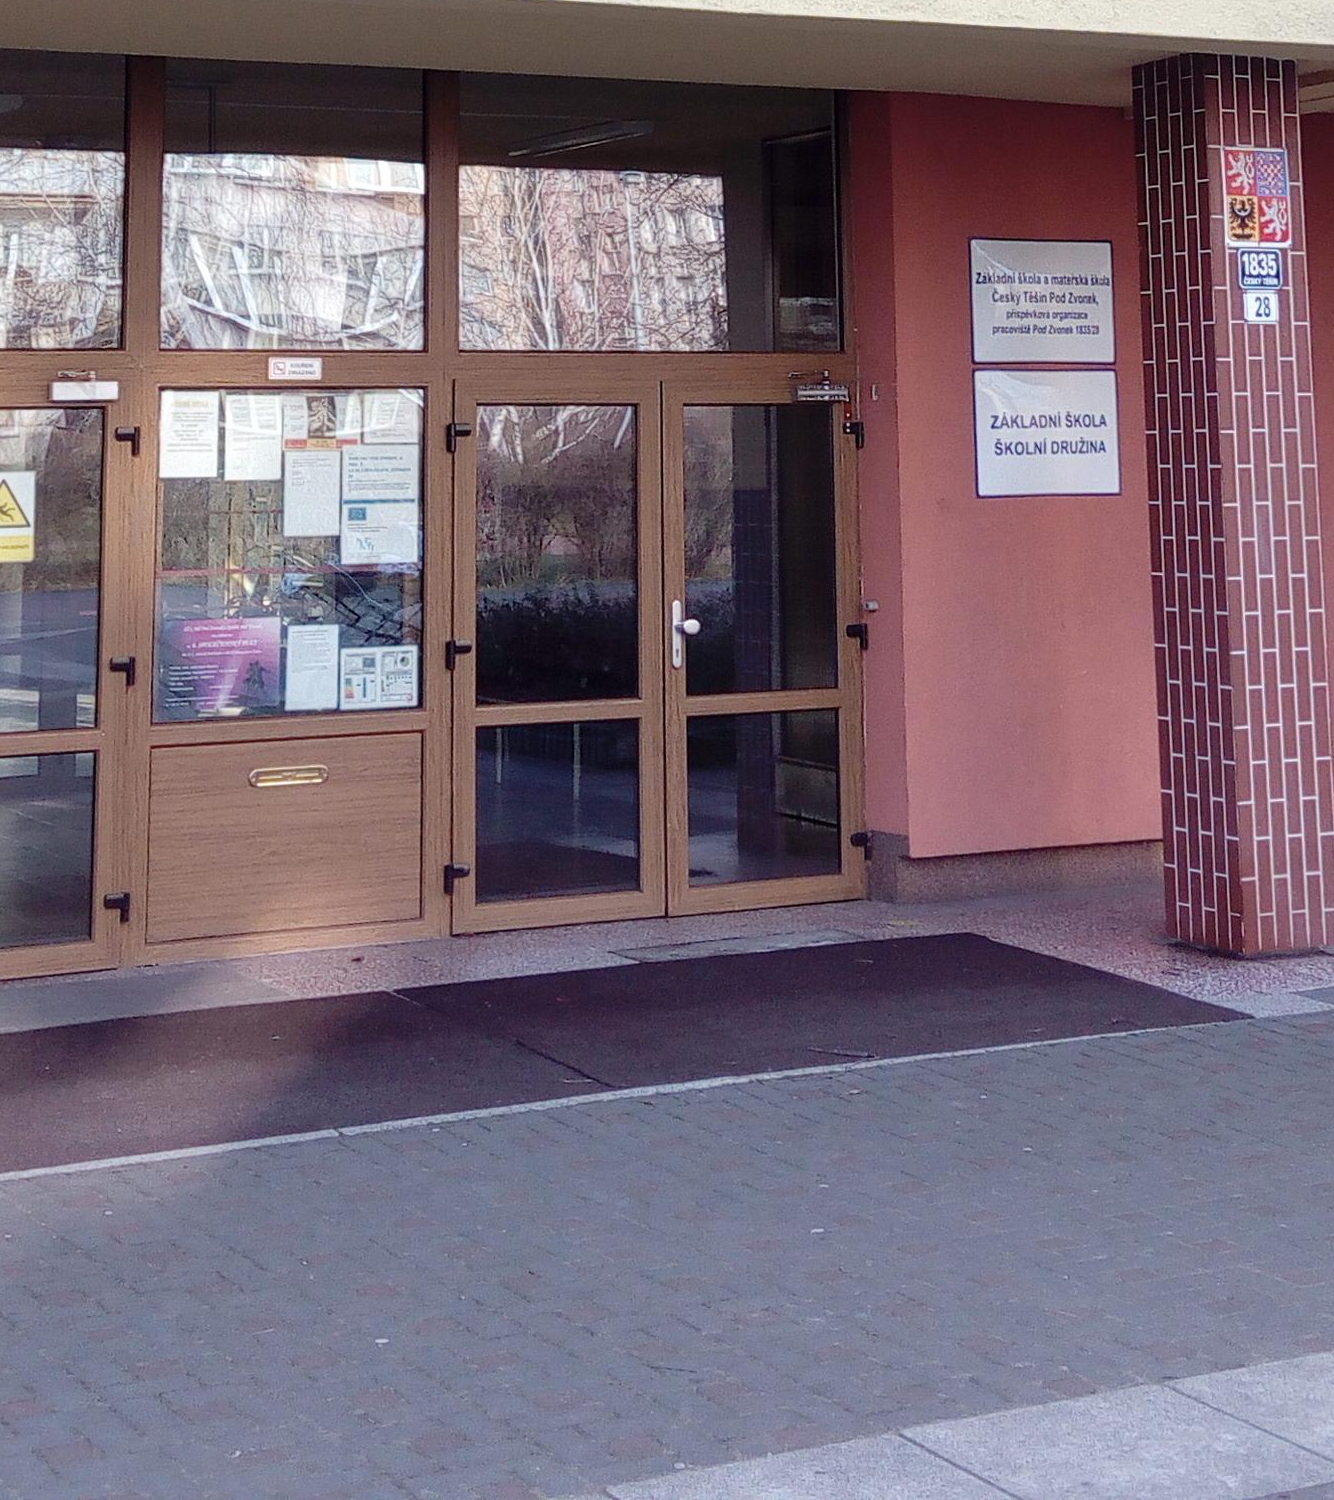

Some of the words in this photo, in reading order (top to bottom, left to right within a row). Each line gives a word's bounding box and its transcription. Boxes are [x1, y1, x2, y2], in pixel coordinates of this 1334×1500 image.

[1242, 253, 1277, 276] 1835
[1018, 272, 1042, 285] škola
[1043, 276, 1049, 285] a
[1091, 274, 1110, 287] škola
[992, 288, 1021, 305] Český
[1023, 291, 1048, 303] Těšín
[1049, 291, 1066, 304] Pod
[1255, 296, 1271, 318] 28
[1032, 325, 1047, 335] Pod
[990, 411, 1062, 429] ZÁKLADNÍ
[1065, 411, 1108, 429] ŠKOLA
[994, 437, 1047, 456] ŠKOLNÍ
[1050, 437, 1107, 455] DRUŽINA
